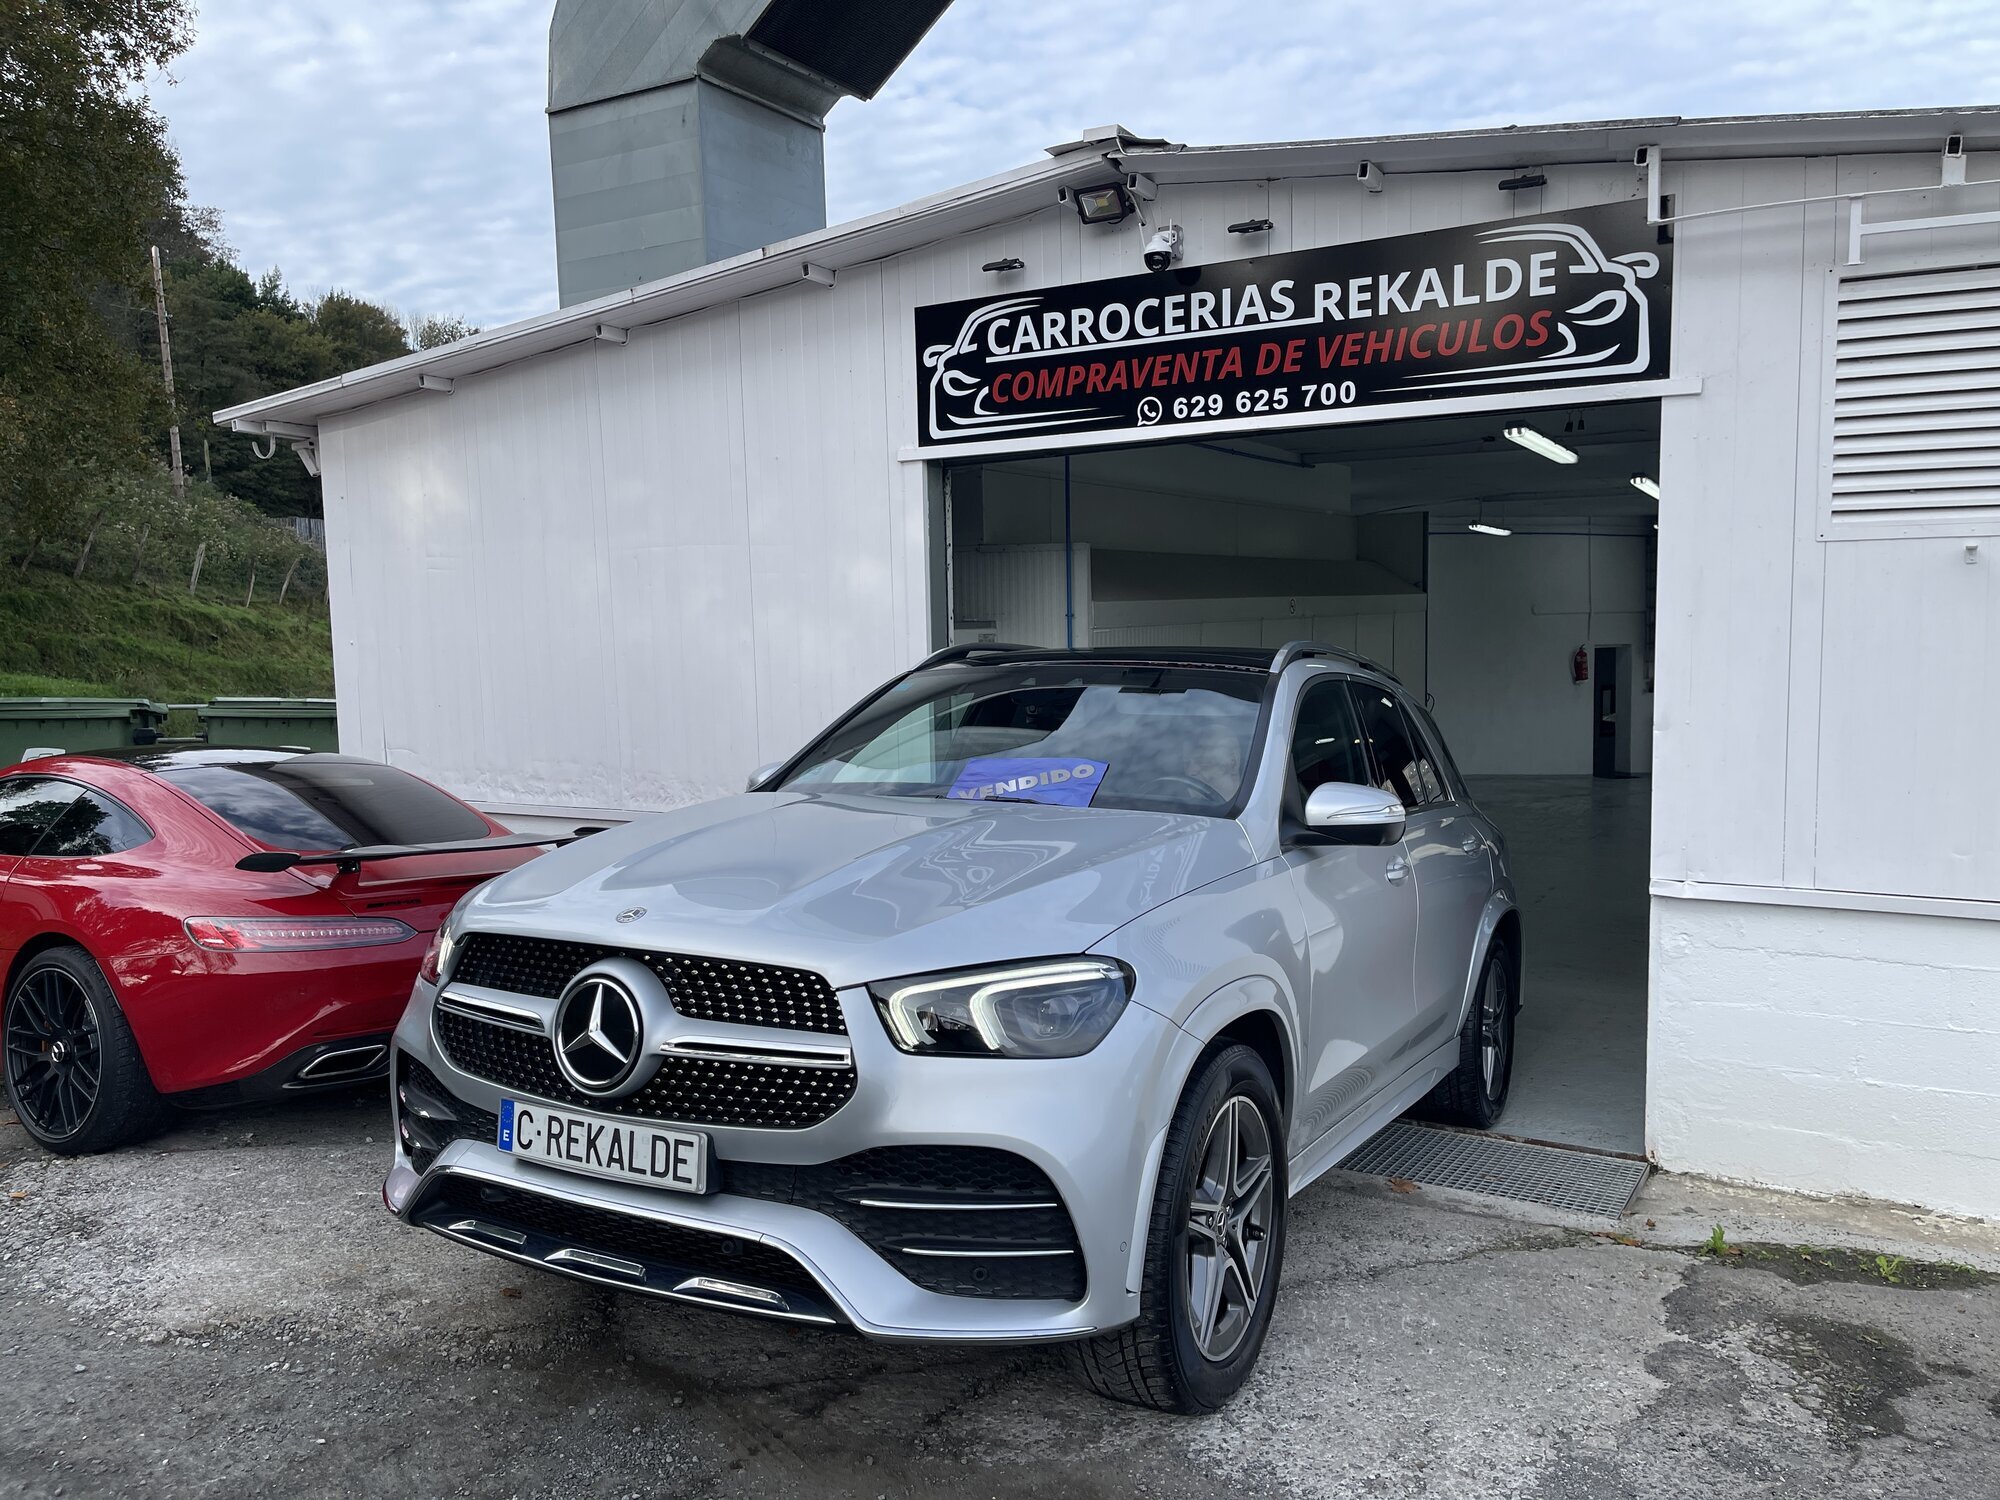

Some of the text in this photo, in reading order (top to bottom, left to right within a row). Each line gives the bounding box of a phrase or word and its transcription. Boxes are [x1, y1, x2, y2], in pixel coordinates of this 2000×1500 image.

[987, 250, 1557, 356] CARROCERIAS REKALDE
[992, 310, 1553, 403] COMPRAVENTA DE VEHICULOS
[1173, 380, 1357, 419] 629 625 700
[956, 763, 1096, 800] VENDIDO
[502, 1129, 510, 1142] E
